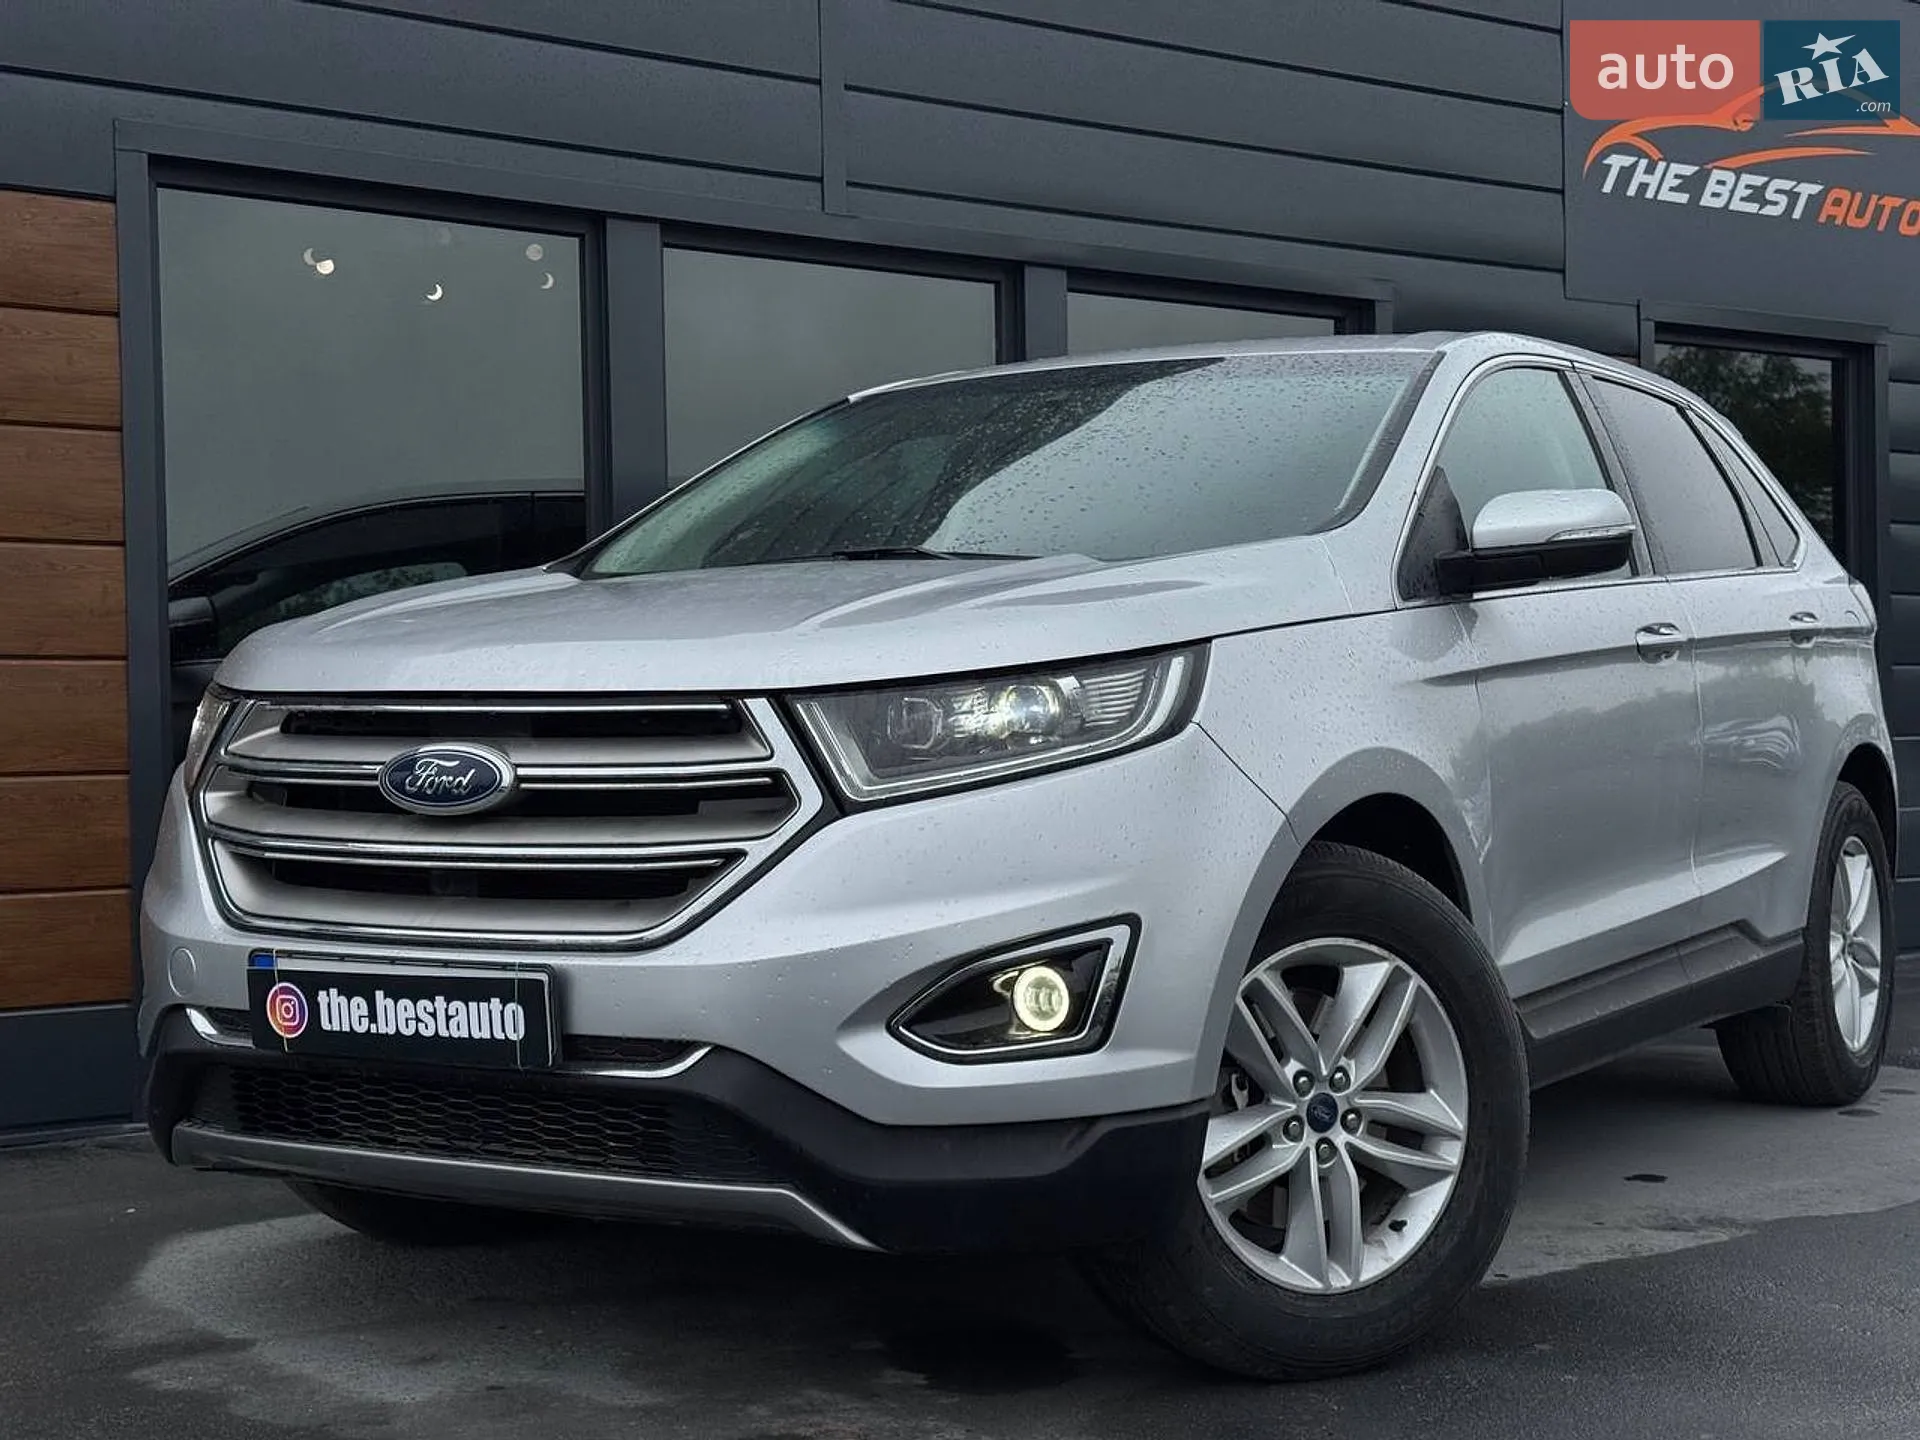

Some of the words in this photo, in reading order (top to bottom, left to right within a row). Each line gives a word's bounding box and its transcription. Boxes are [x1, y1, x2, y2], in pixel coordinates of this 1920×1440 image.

[1601, 154, 1700, 204] THE
[1699, 169, 1825, 220] BEST
[1817, 187, 1920, 237] AUTO
[405, 758, 476, 795] Ford
[317, 988, 525, 1041] the.bestauto
